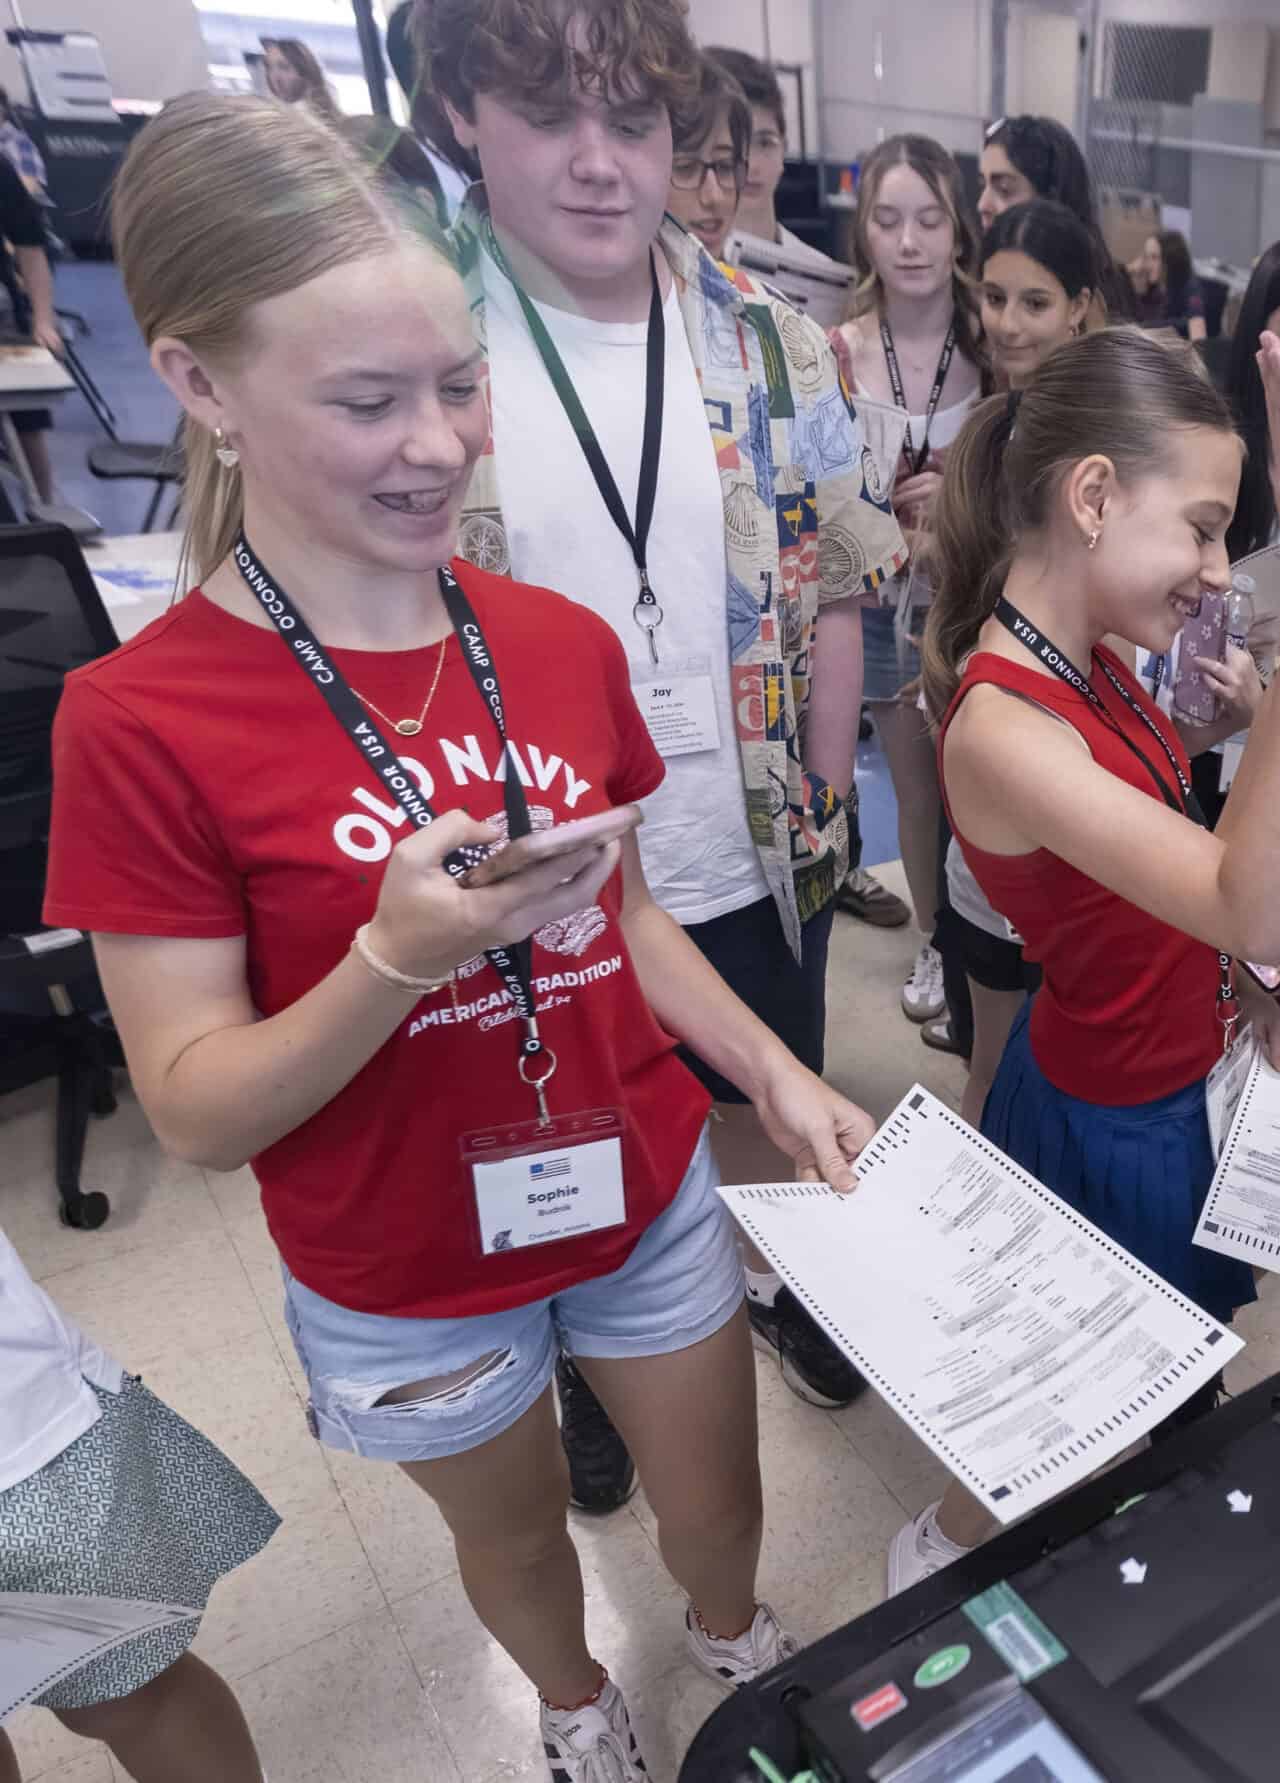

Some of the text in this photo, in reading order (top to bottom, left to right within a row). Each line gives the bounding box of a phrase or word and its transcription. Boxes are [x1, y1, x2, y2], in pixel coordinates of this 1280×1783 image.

[235, 542, 334, 684] CAMP O'CONNOR
[463, 624, 489, 667] CAMP
[1013, 618, 1098, 704] O'CONNOR USA
[333, 735, 592, 862] OLD NAVY
[354, 722, 432, 826] ONNOR USA
[408, 989, 518, 1038] AMERICAN
[488, 946, 530, 1017] NNOR US
[527, 1186, 579, 1204] Sophie
